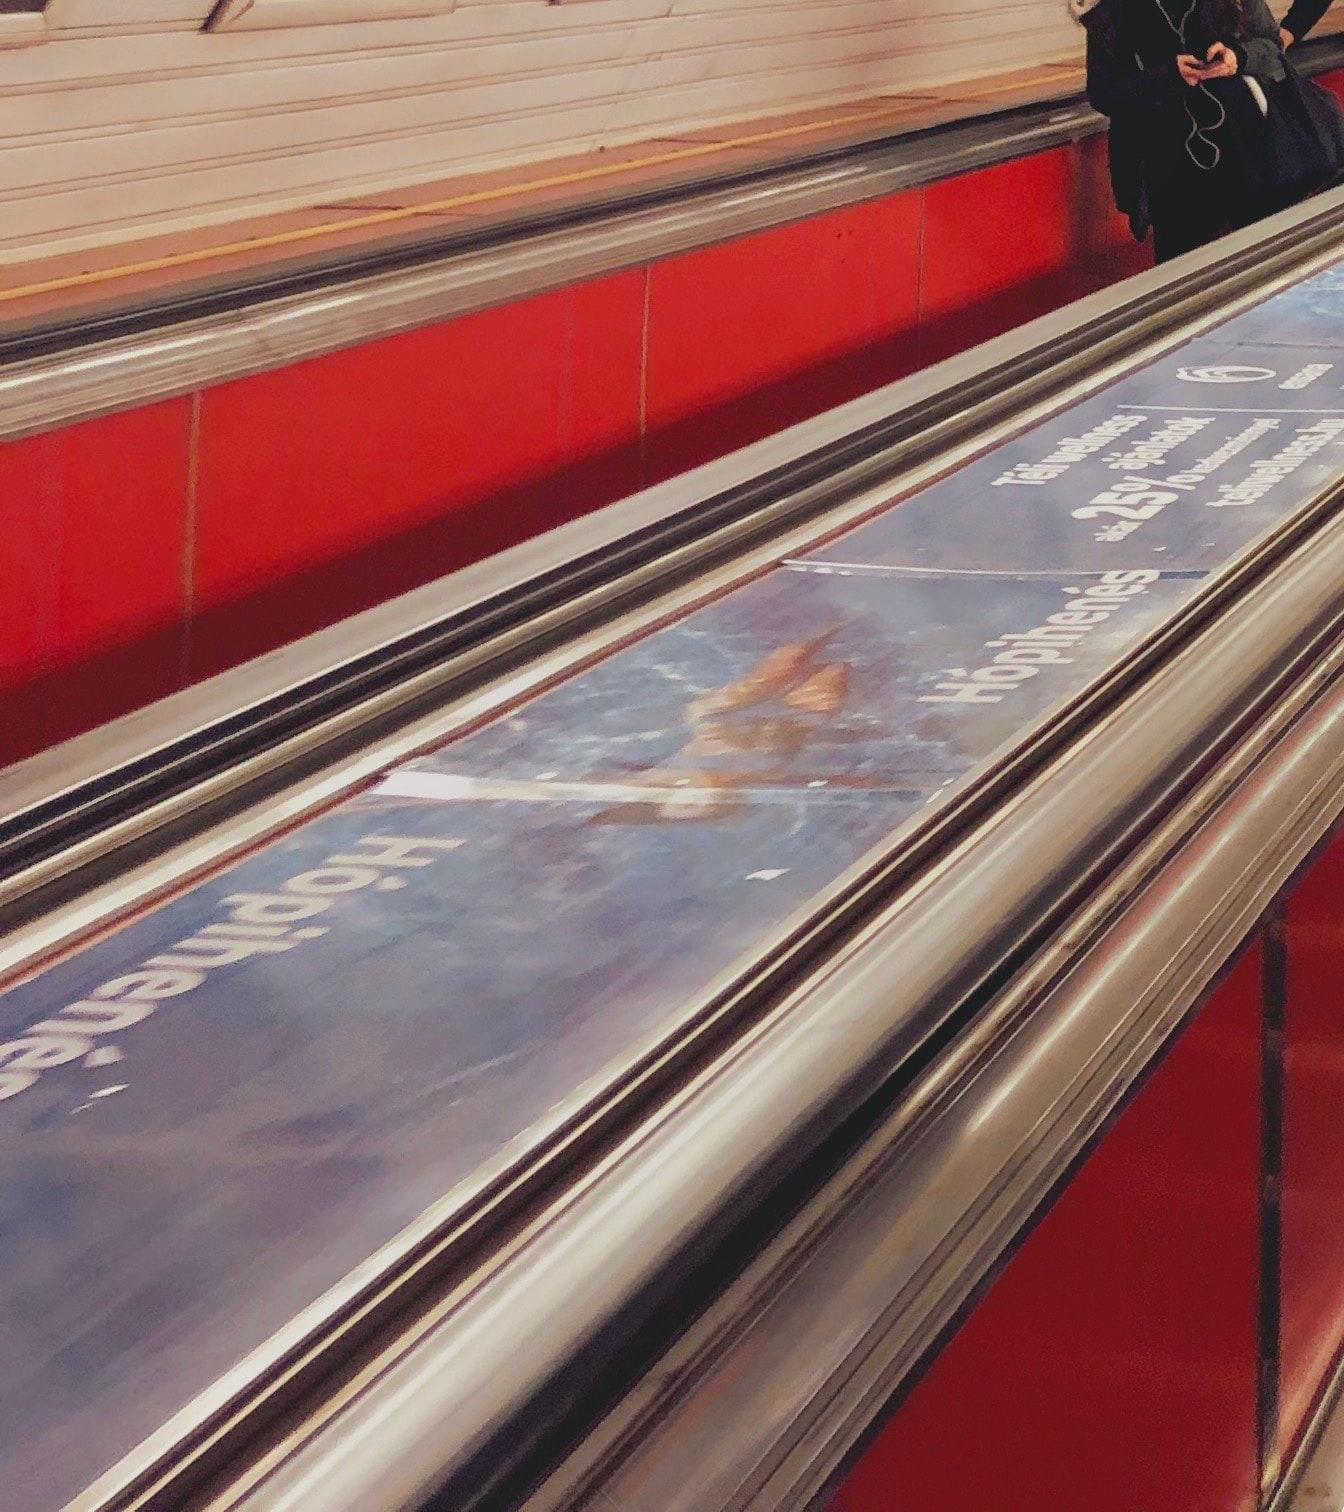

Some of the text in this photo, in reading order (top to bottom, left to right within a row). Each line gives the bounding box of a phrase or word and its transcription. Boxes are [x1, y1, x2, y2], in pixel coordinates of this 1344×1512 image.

[1041, 414, 1148, 471] wellness
[1102, 417, 1217, 470] ajánlatok
[1071, 466, 1205, 520] 25%
[916, 569, 1161, 704] Hópihenés
